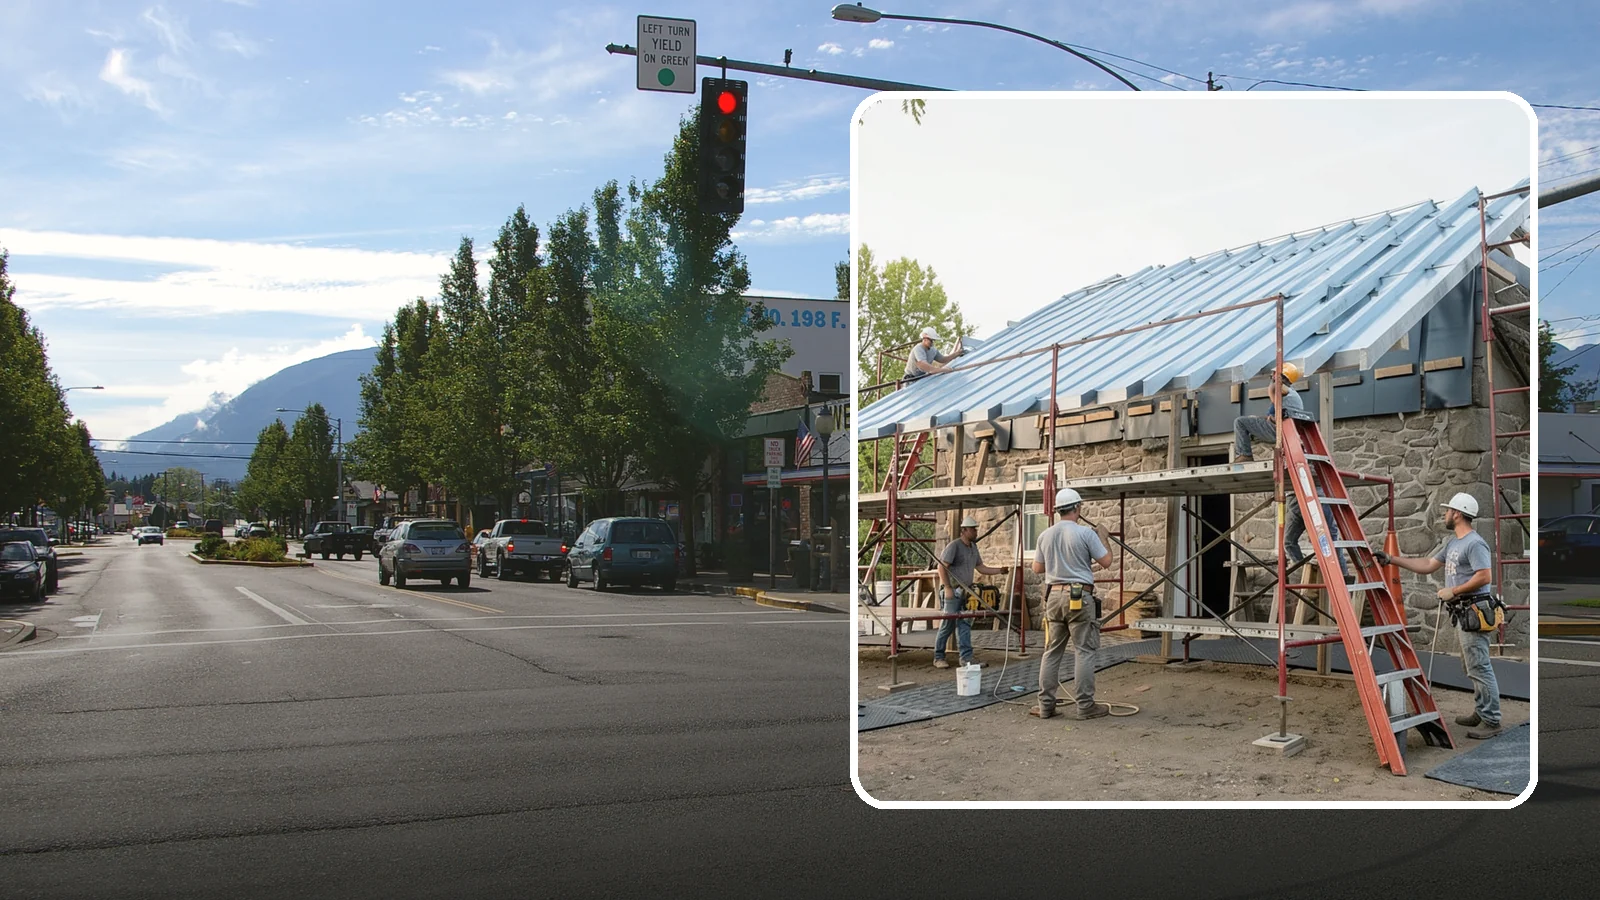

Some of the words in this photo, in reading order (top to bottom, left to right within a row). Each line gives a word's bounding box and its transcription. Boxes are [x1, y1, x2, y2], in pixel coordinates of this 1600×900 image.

[643, 24, 663, 34] LEFT
[668, 26, 690, 36] TURN
[652, 38, 682, 51] YIELD
[644, 53, 656, 63] ON
[661, 55, 688, 66] GREEN
[791, 309, 826, 328] 198
